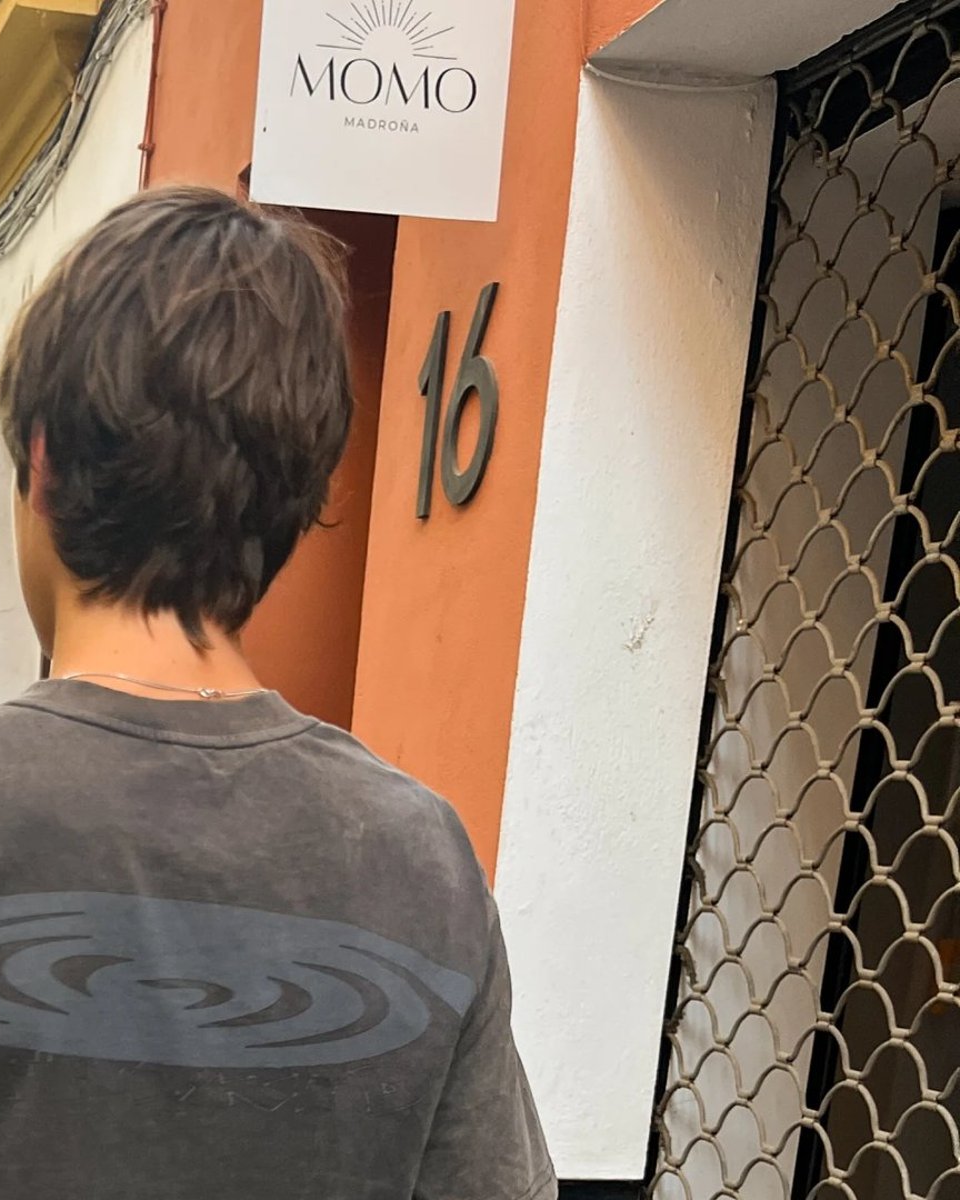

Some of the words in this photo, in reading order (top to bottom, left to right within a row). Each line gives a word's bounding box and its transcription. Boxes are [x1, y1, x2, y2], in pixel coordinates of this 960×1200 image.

[290, 53, 477, 113] MOMO
[344, 116, 419, 133] MADROÑA
[416, 282, 500, 518] 16
